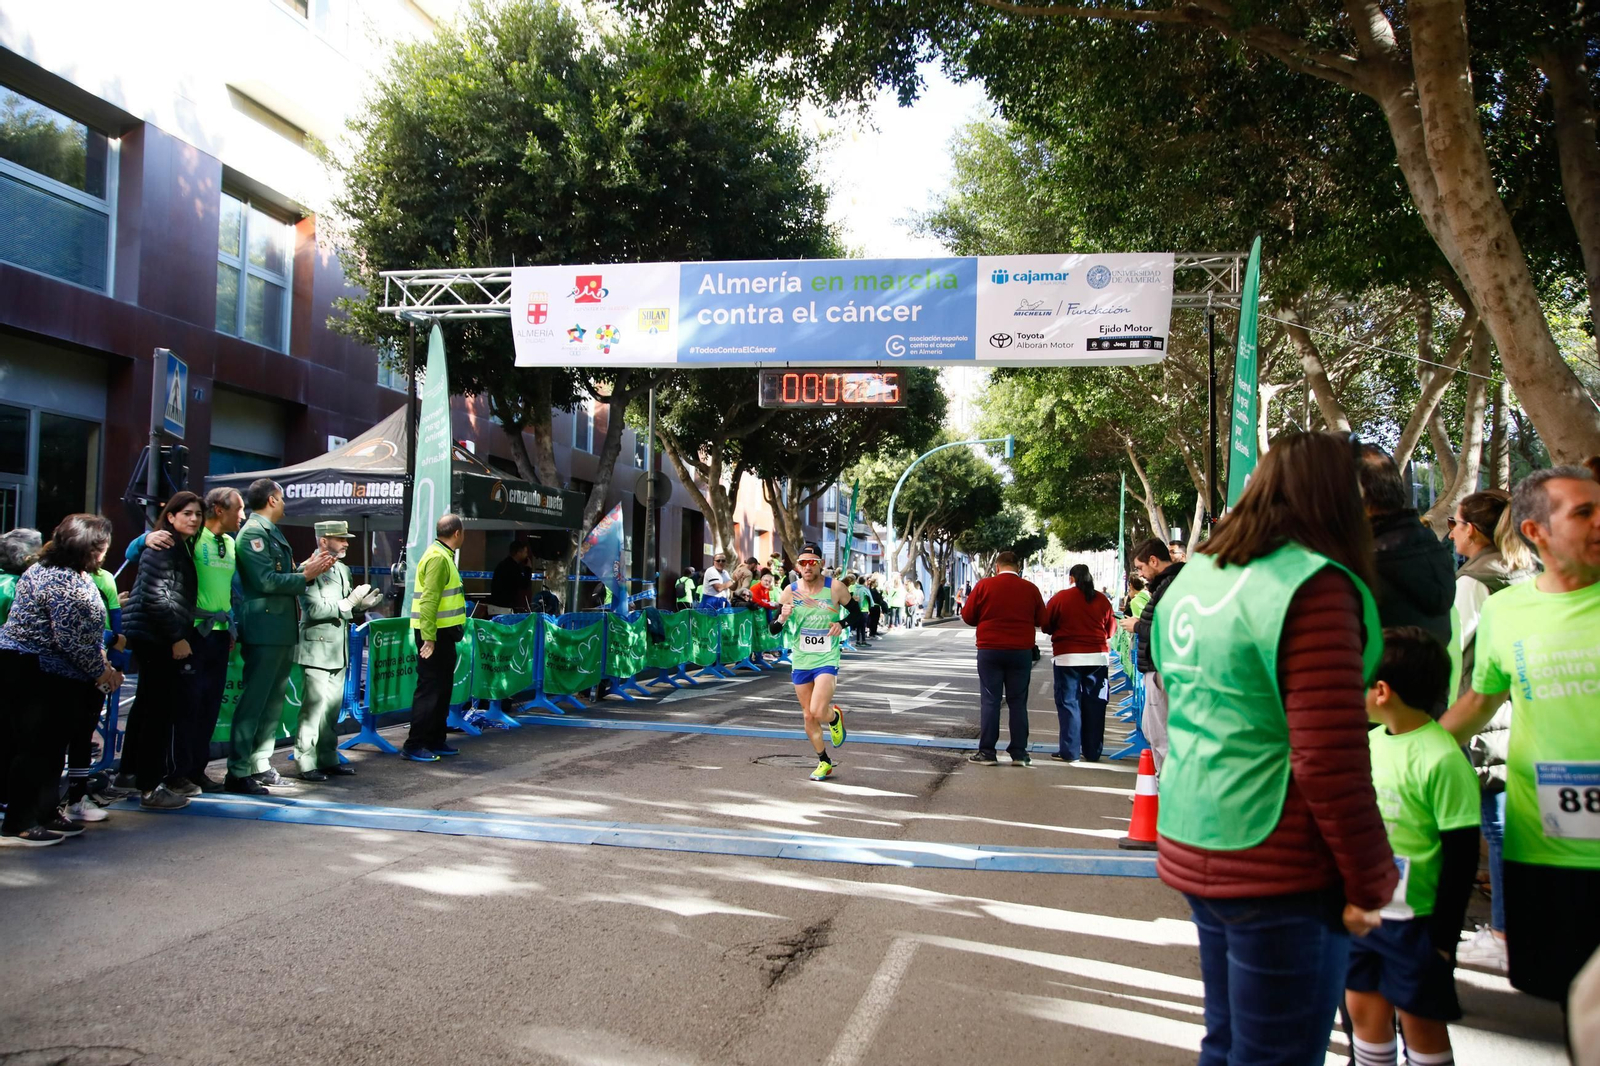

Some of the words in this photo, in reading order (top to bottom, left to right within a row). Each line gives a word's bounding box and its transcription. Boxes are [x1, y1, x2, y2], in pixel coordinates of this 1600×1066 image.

[698, 271, 802, 294] Almería
[811, 275, 843, 291] en
[853, 269, 959, 292] marcha
[1012, 270, 1070, 285] cajamar
[1125, 275, 1161, 284] ALMERÍA
[697, 303, 784, 325] contra
[792, 301, 818, 323] el
[825, 300, 922, 323] cáncer
[1066, 303, 1131, 316] Fundación
[517, 328, 554, 337] ALMERÍA
[1099, 325, 1122, 334] Ejido
[1123, 324, 1153, 333] Motor
[689, 346, 777, 355] #TodosContraElCáncer
[1016, 341, 1049, 349] Alborán
[805, 635, 825, 645] 604
[396, 666, 413, 677] solo
[1513, 640, 1534, 702] ALMERÍA
[1531, 660, 1596, 680] contra
